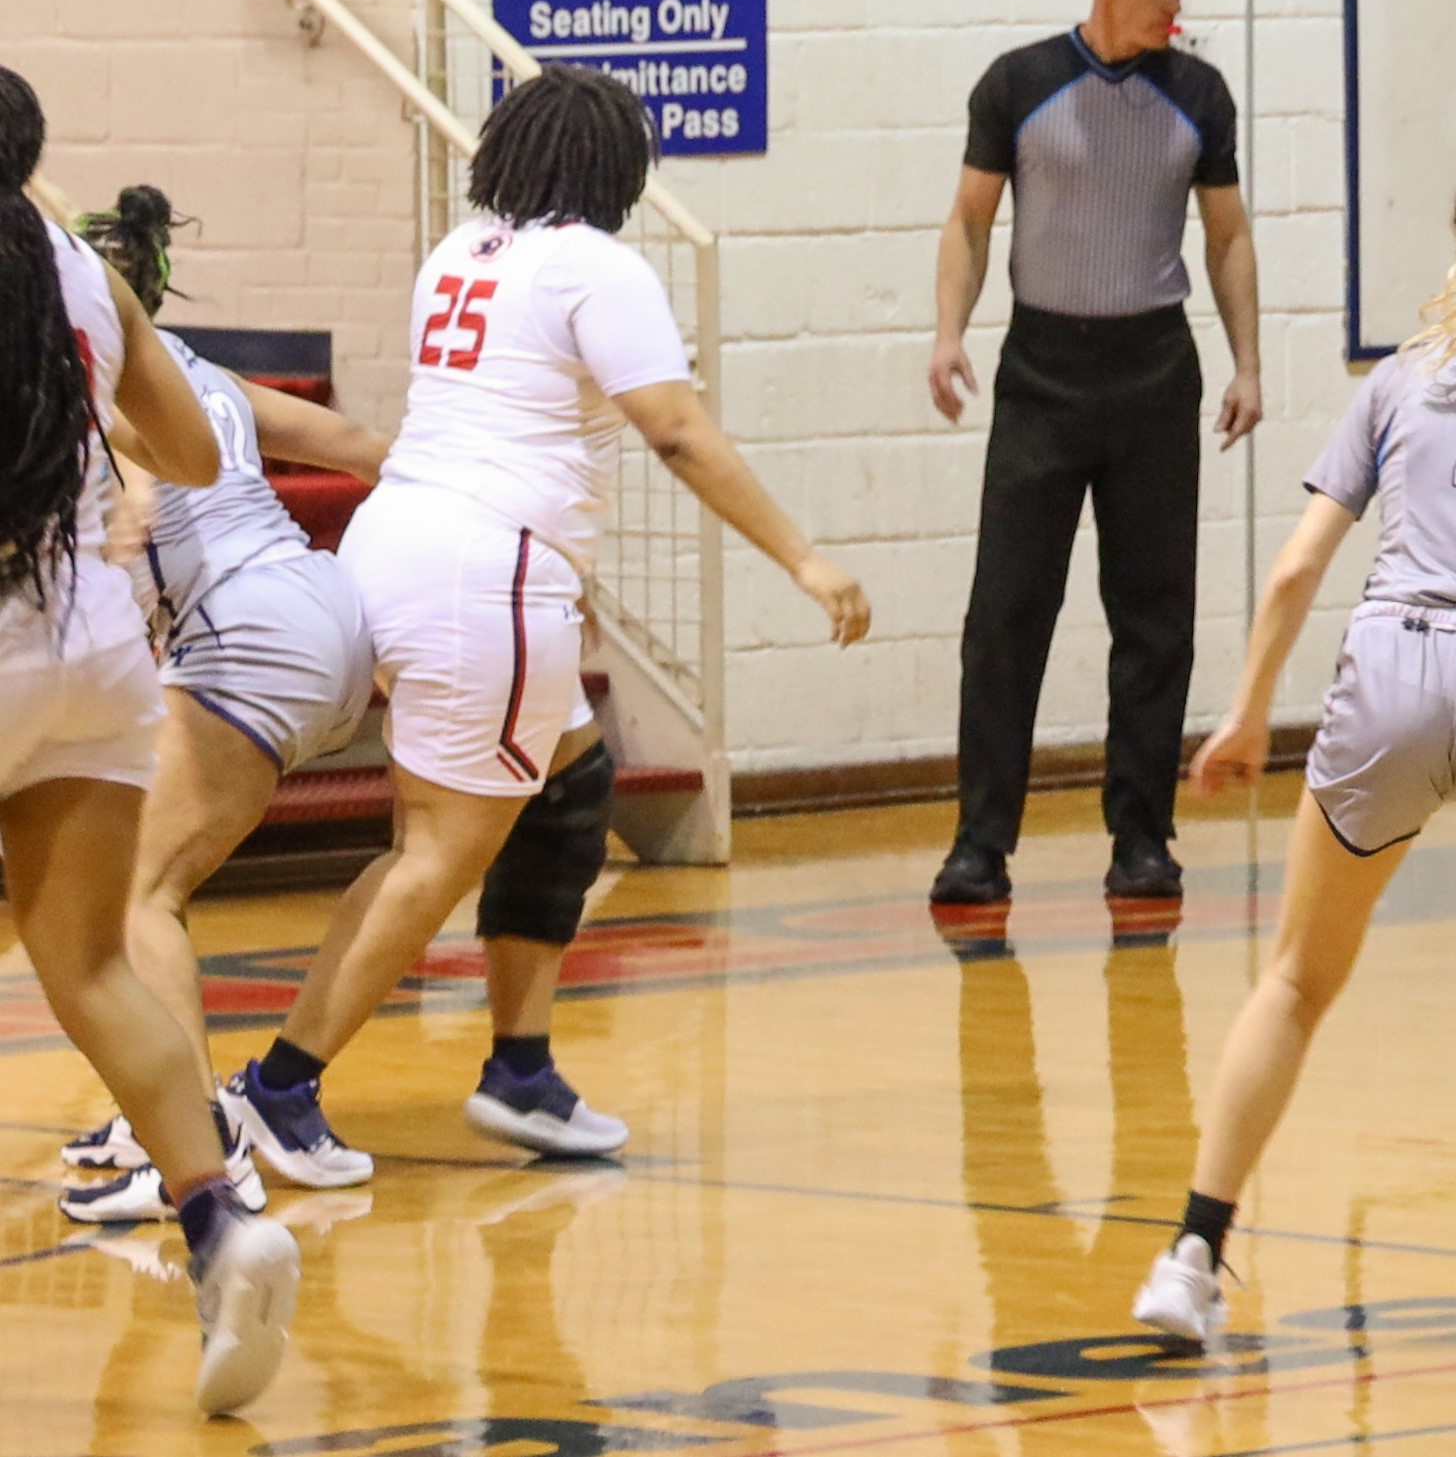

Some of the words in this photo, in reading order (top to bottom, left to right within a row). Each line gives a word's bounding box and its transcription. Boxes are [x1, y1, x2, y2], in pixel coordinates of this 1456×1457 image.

[529, 0, 652, 44] Seating
[602, 60, 748, 96] mittance
[661, 101, 740, 140] Pass
[418, 273, 499, 372] 25
